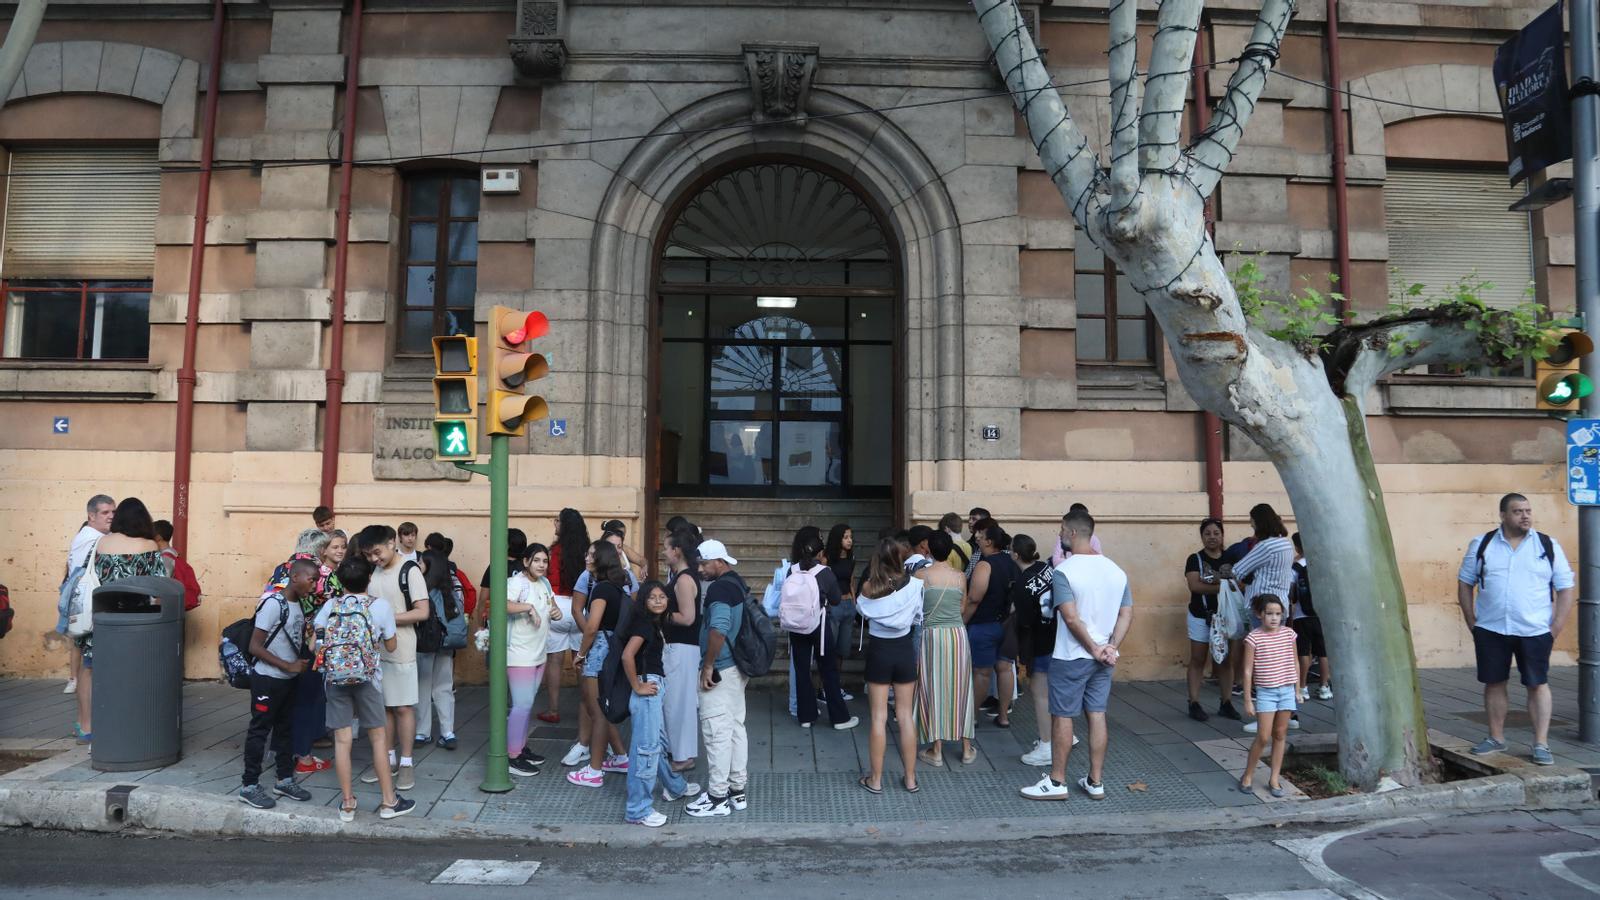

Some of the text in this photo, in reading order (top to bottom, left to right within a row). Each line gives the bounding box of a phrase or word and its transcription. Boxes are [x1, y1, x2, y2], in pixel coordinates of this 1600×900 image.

[386, 417, 435, 430] INSTIT
[987, 429, 997, 437] 14
[376, 447, 434, 460] J. ALCO
